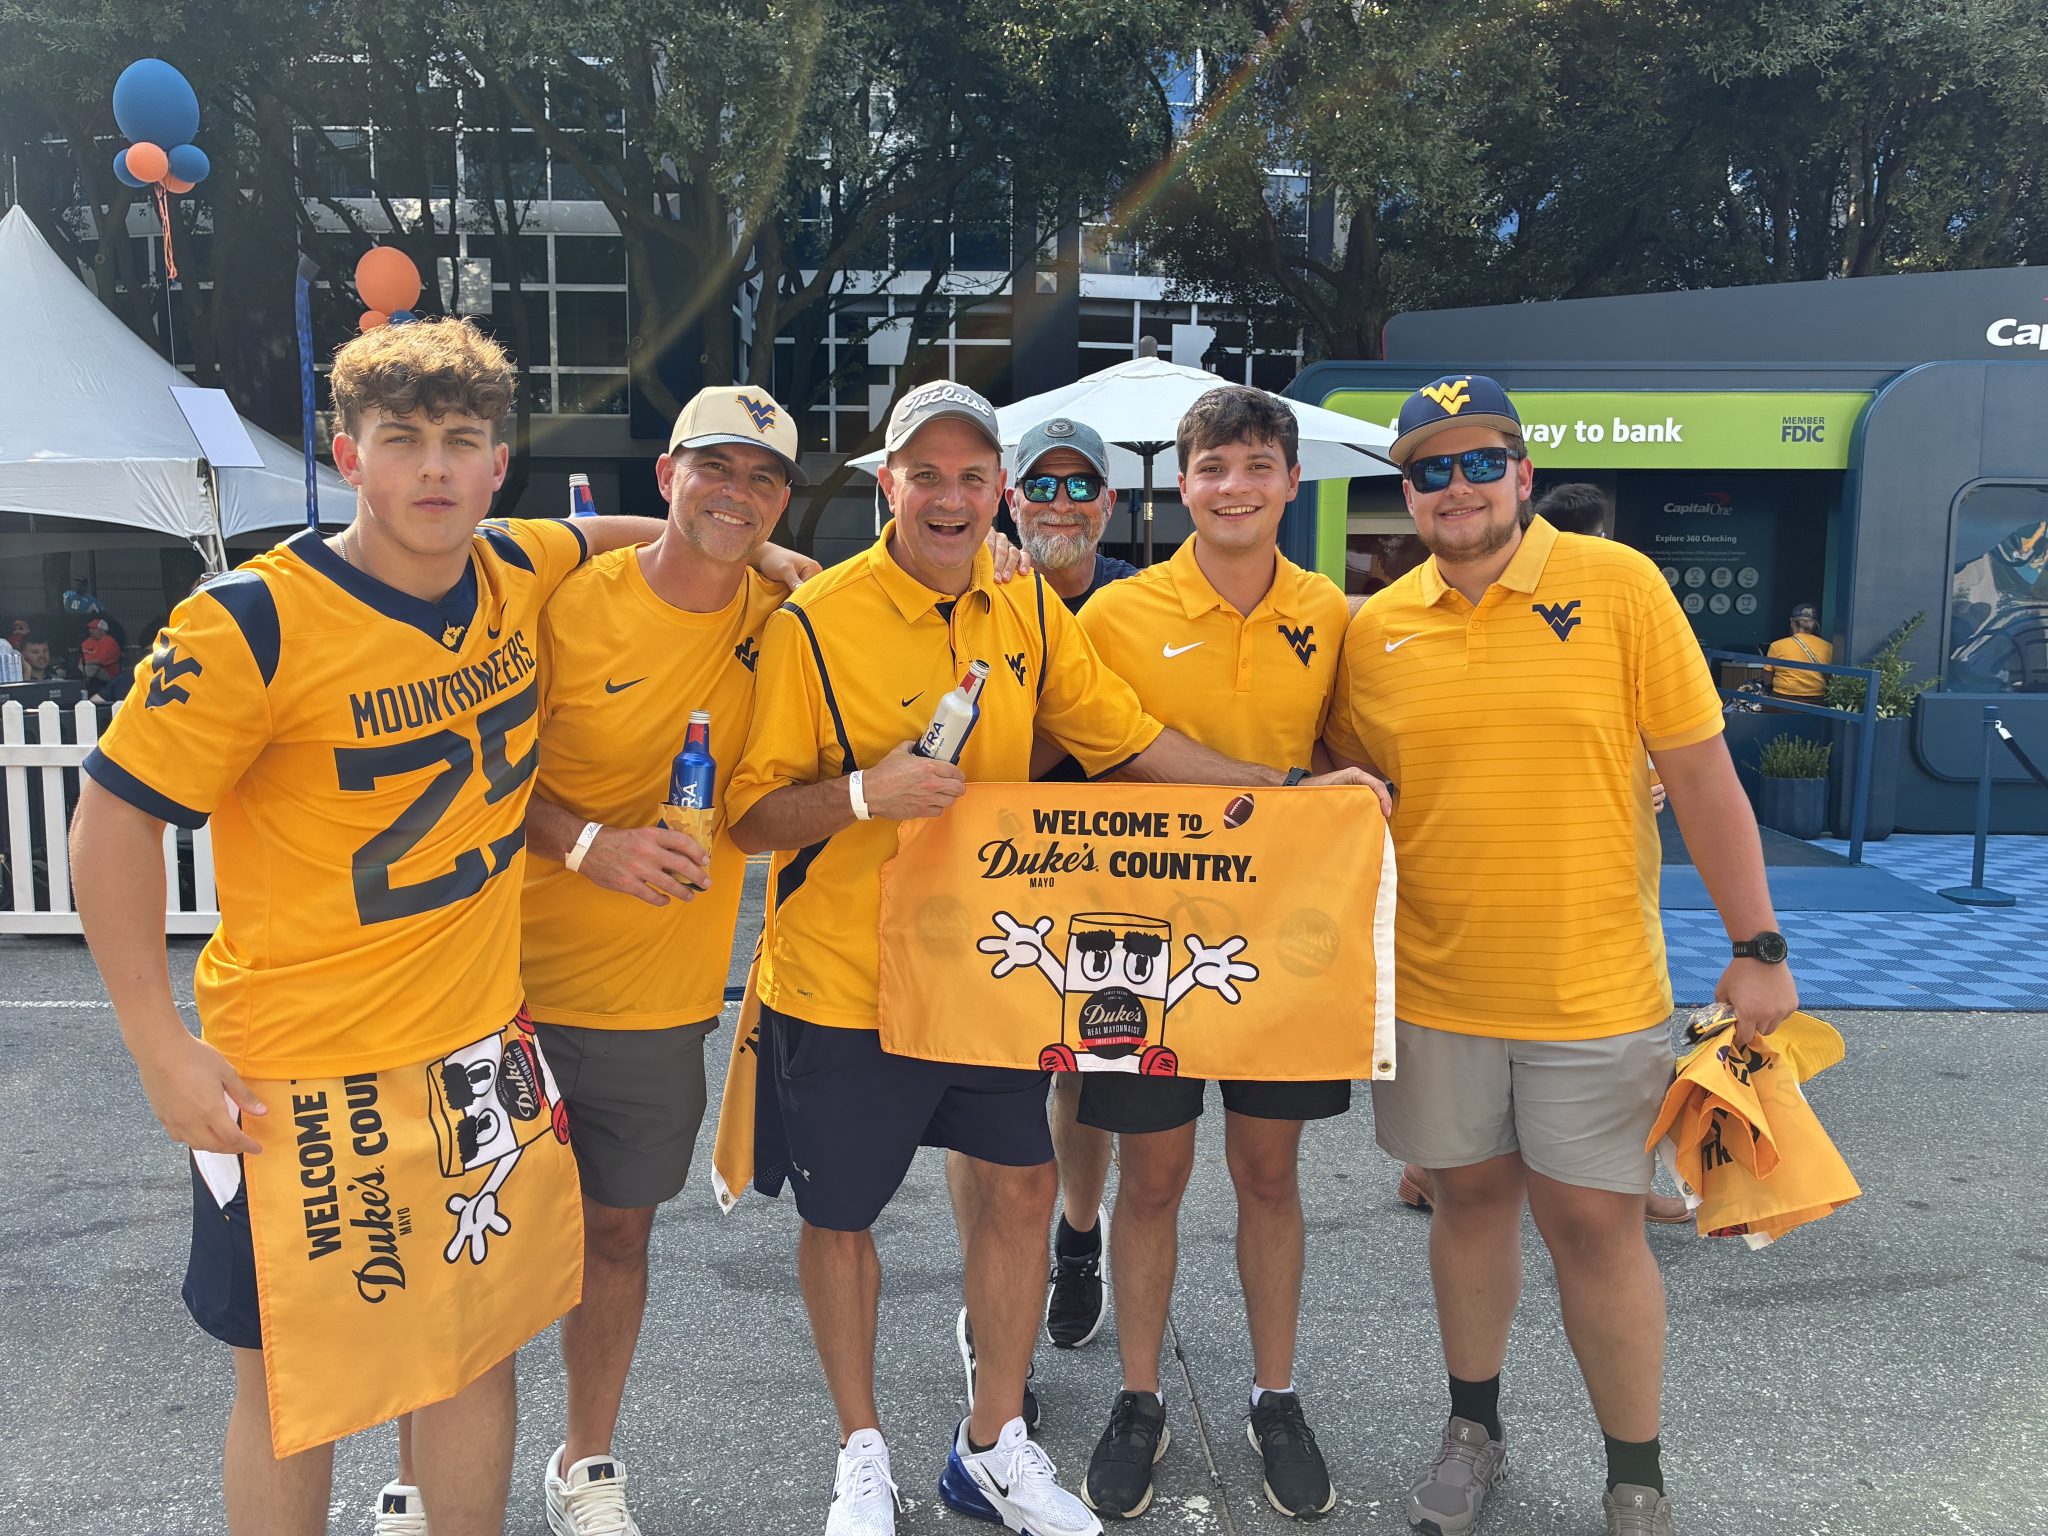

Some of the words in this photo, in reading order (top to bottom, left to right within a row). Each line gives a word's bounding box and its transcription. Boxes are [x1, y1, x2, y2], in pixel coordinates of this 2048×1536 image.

[899, 386, 991, 422] Titleist
[1574, 420, 1604, 443] to
[1612, 416, 1684, 443] bank
[1781, 425, 1825, 442] FDIC
[1782, 416, 1825, 425] MEMBER
[1655, 534, 1685, 544] Explore
[1686, 534, 1700, 542] 360
[1701, 534, 1737, 544] Checking
[349, 630, 537, 739] MOUNTAINEERS
[1032, 808, 1170, 838] WELCOME
[1177, 813, 1204, 833] TO
[977, 837, 1098, 879] Duke's
[1109, 850, 1257, 883] COUNTRY.
[1029, 877, 1055, 888] MAYO
[1083, 1003, 1142, 1025] Duke's
[1087, 1027, 1102, 1037] REAL
[1103, 1024, 1141, 1036] MAYONNAISE
[292, 1091, 342, 1261] WELCOME
[346, 1164, 406, 1304] Duke's
[397, 1206, 413, 1236] MAYO
